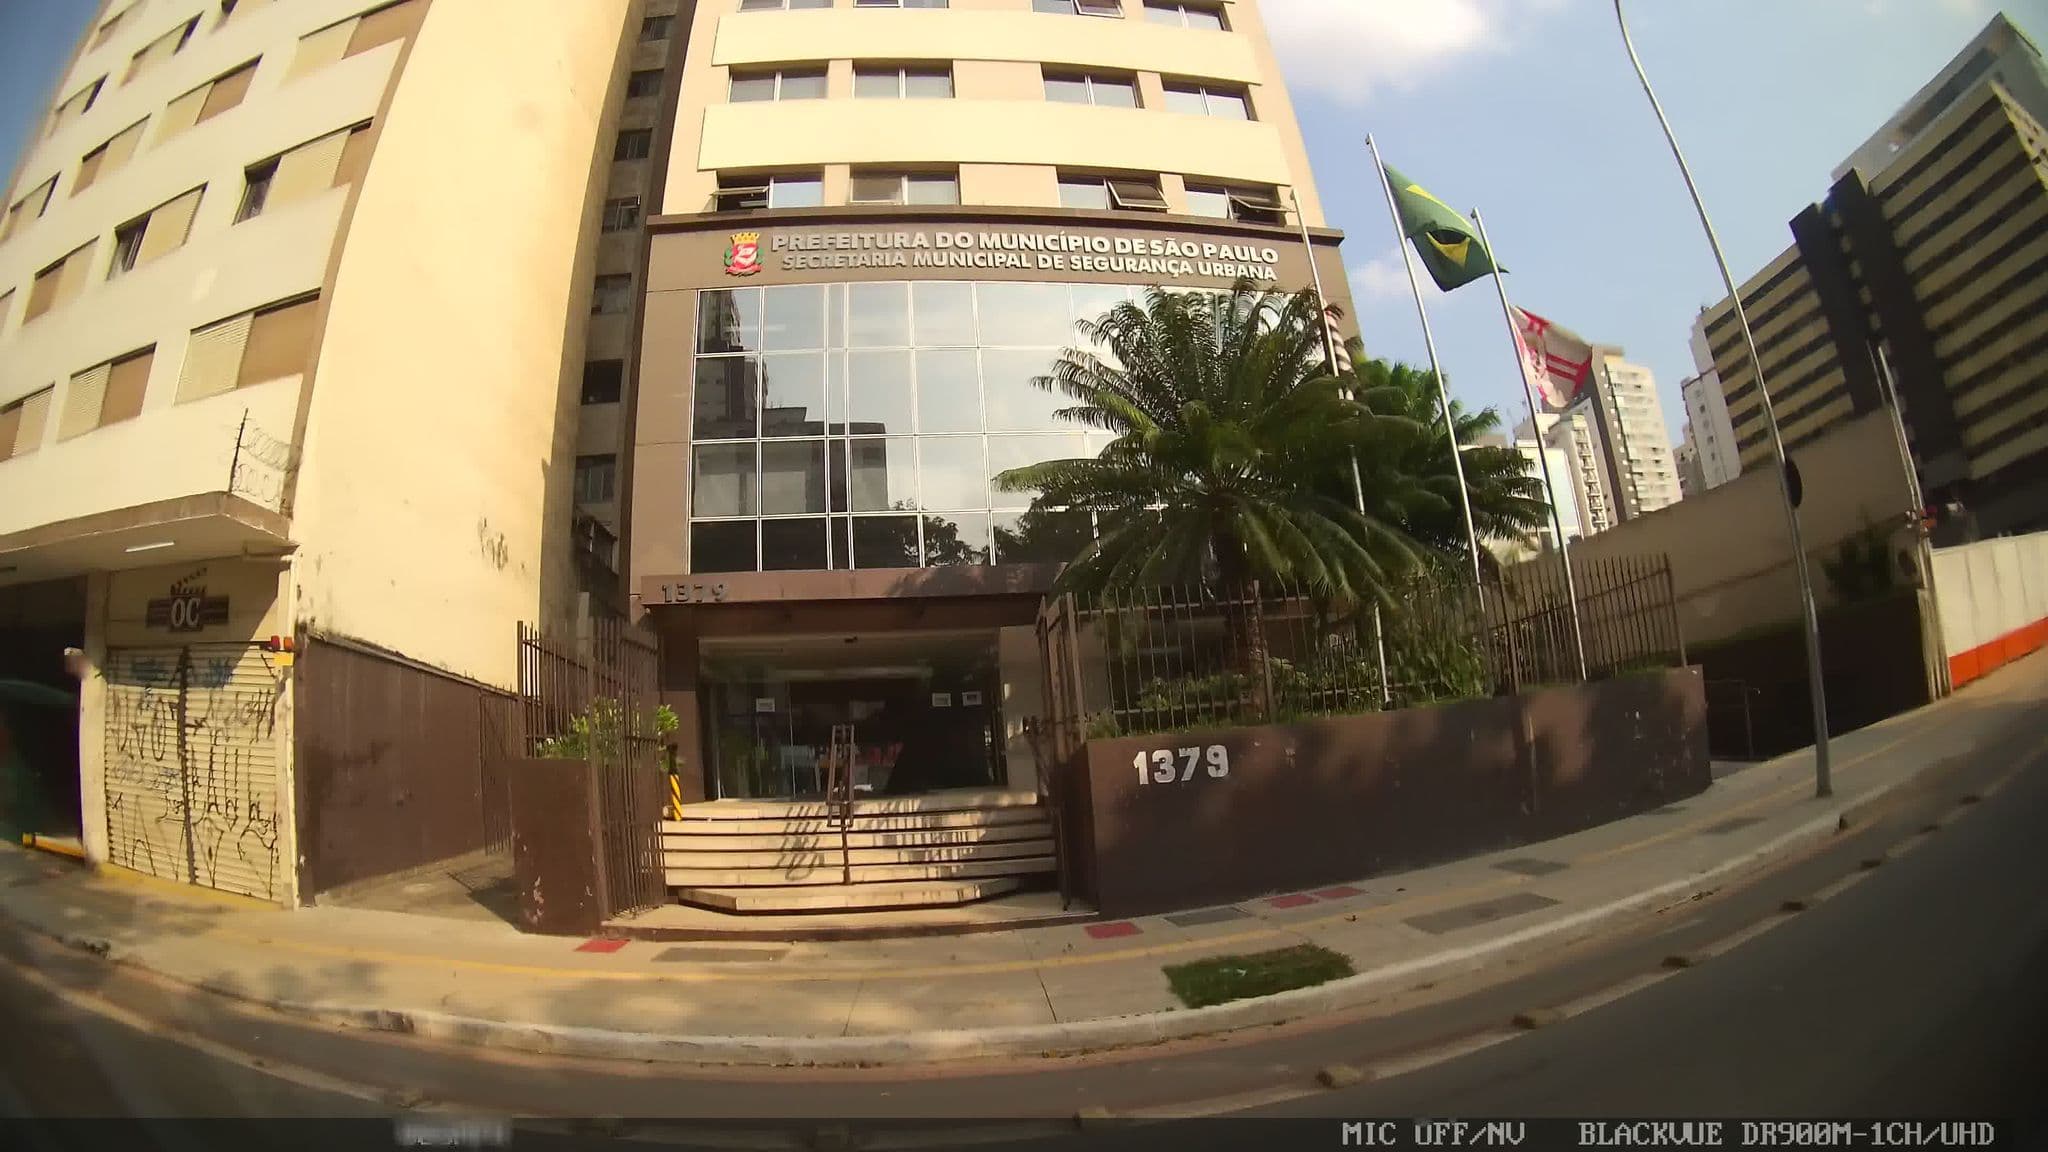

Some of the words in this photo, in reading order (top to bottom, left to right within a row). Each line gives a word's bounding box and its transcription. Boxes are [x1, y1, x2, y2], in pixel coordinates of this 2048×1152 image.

[771, 231, 930, 251] PREFEITURA
[934, 231, 975, 249] DO
[979, 231, 1110, 253] MUNICÍPIO
[1113, 237, 1145, 255] DE
[1150, 237, 1200, 258] SÃO
[1201, 243, 1279, 264] PAULO
[781, 251, 907, 270] SECRETARIA
[912, 251, 1031, 269] MUNICIPAL
[1037, 253, 1064, 270] DE
[1070, 256, 1194, 278] SEGURANÇA
[1198, 261, 1277, 281] URBANA
[659, 584, 727, 603] 1379
[171, 597, 201, 627] OC
[1133, 745, 1229, 785] 1379
